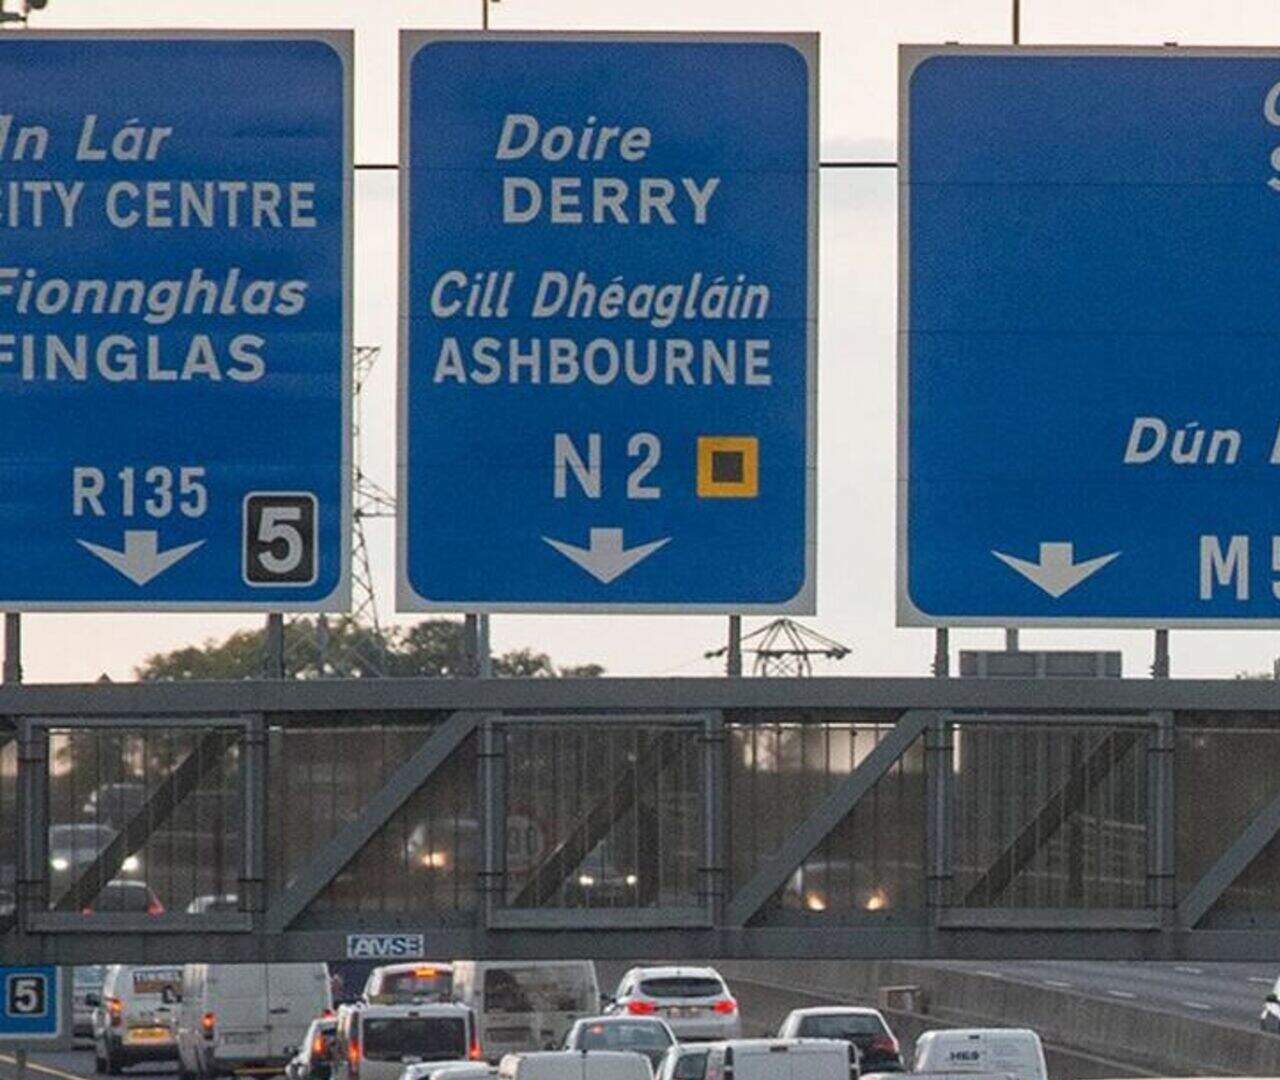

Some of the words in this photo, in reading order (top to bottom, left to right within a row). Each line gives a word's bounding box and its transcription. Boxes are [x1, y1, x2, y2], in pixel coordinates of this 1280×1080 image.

[76, 114, 173, 161] Lár
[495, 114, 652, 162] Doire
[0, 181, 85, 227] ITY
[105, 180, 318, 228] CENTRE
[503, 176, 721, 225] DERRY
[430, 271, 515, 318] Cill
[532, 271, 771, 327] Dhéagláin
[433, 336, 773, 386] ASHBOURNE
[1122, 416, 1242, 466] Dún
[72, 466, 209, 519] R135
[257, 506, 304, 574] 5
[14, 978, 38, 1012] 5
